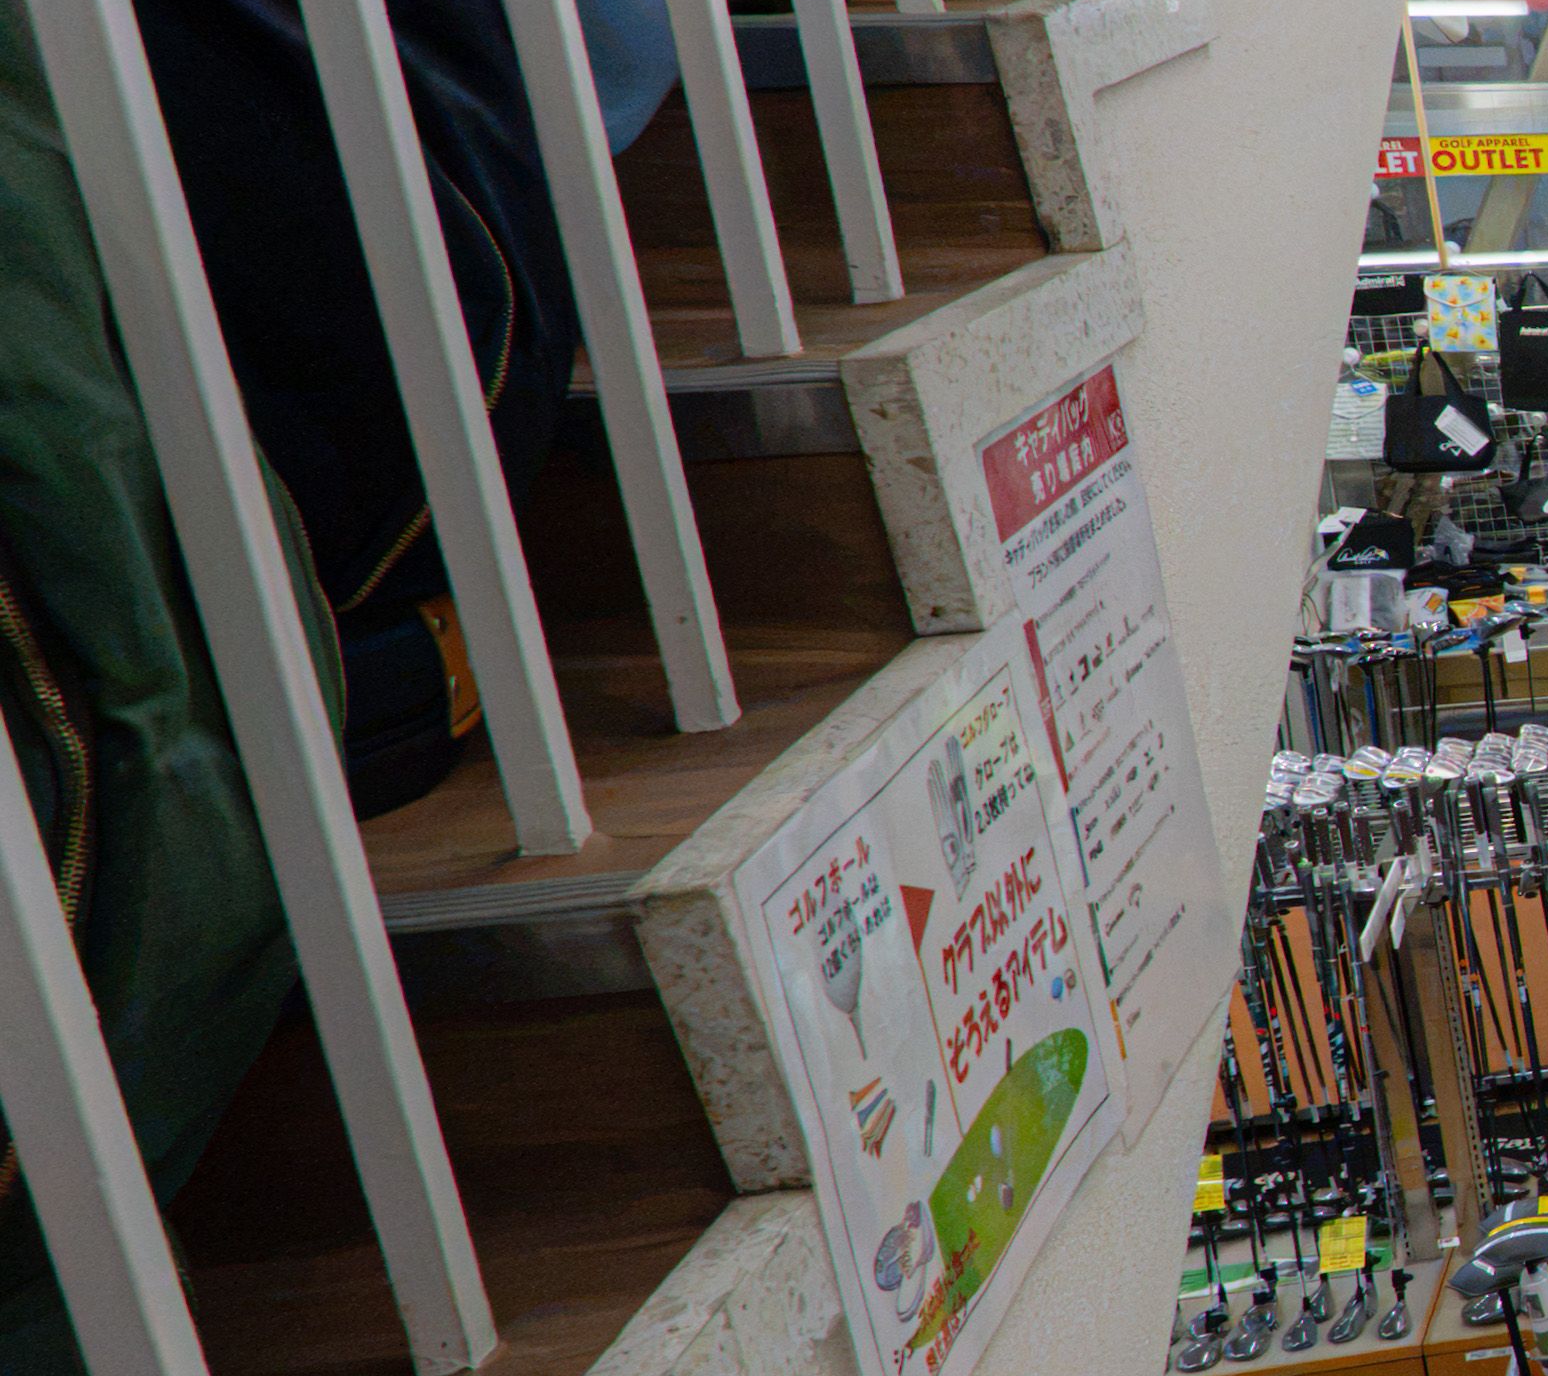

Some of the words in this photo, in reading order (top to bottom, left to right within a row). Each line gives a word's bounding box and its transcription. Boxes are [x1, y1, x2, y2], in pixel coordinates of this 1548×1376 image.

[1432, 147, 1545, 171] OUTLET
[1440, 138, 1471, 148] GOLF
[1475, 137, 1530, 147] APPAREL
[1015, 383, 1088, 466] キャディバッグ
[788, 836, 871, 935] ゴルフボール
[942, 846, 1042, 995] クラブ以外に
[949, 906, 1068, 1084] そろえるアイテム
